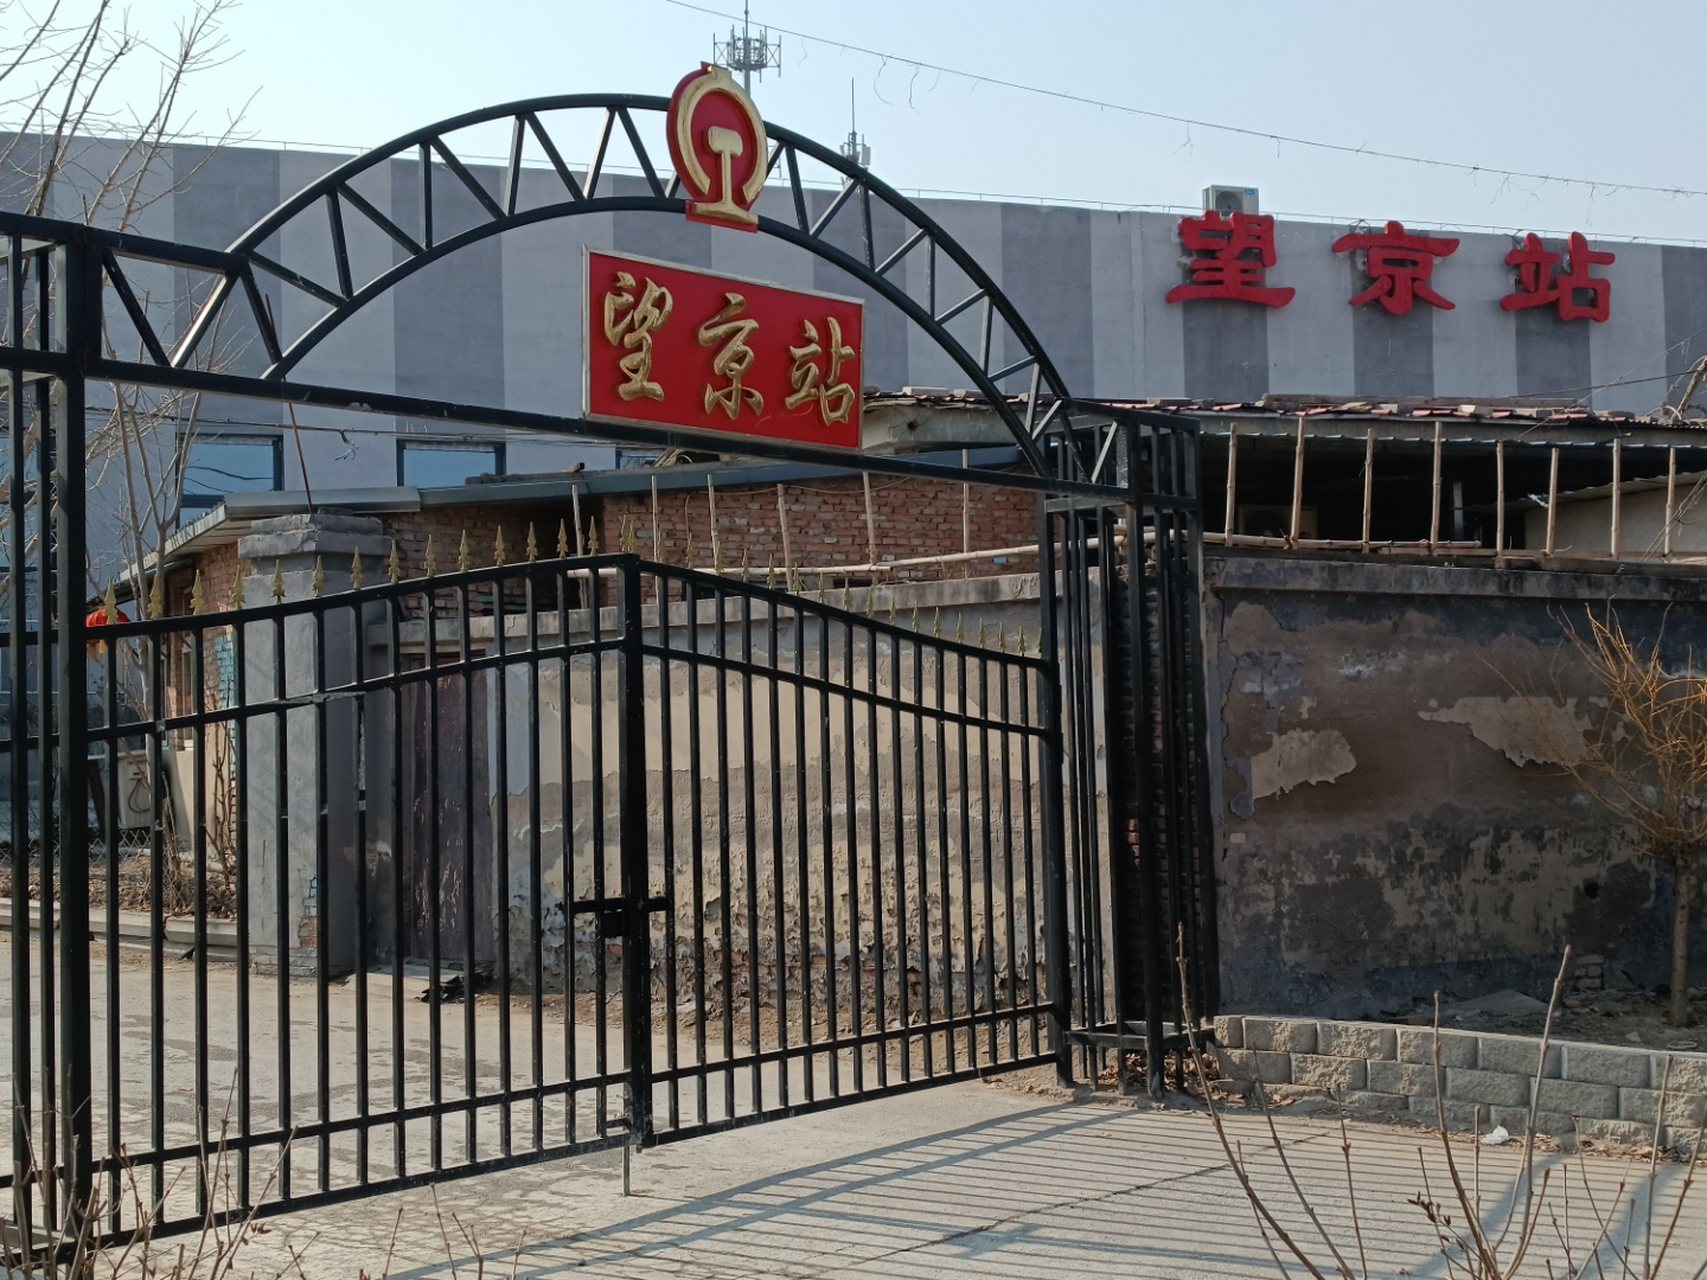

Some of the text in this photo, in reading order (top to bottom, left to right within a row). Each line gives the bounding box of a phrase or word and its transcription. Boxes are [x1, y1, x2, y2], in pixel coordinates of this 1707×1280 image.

[1166, 210, 1616, 322] 望京站
[604, 271, 855, 426] 望京站
